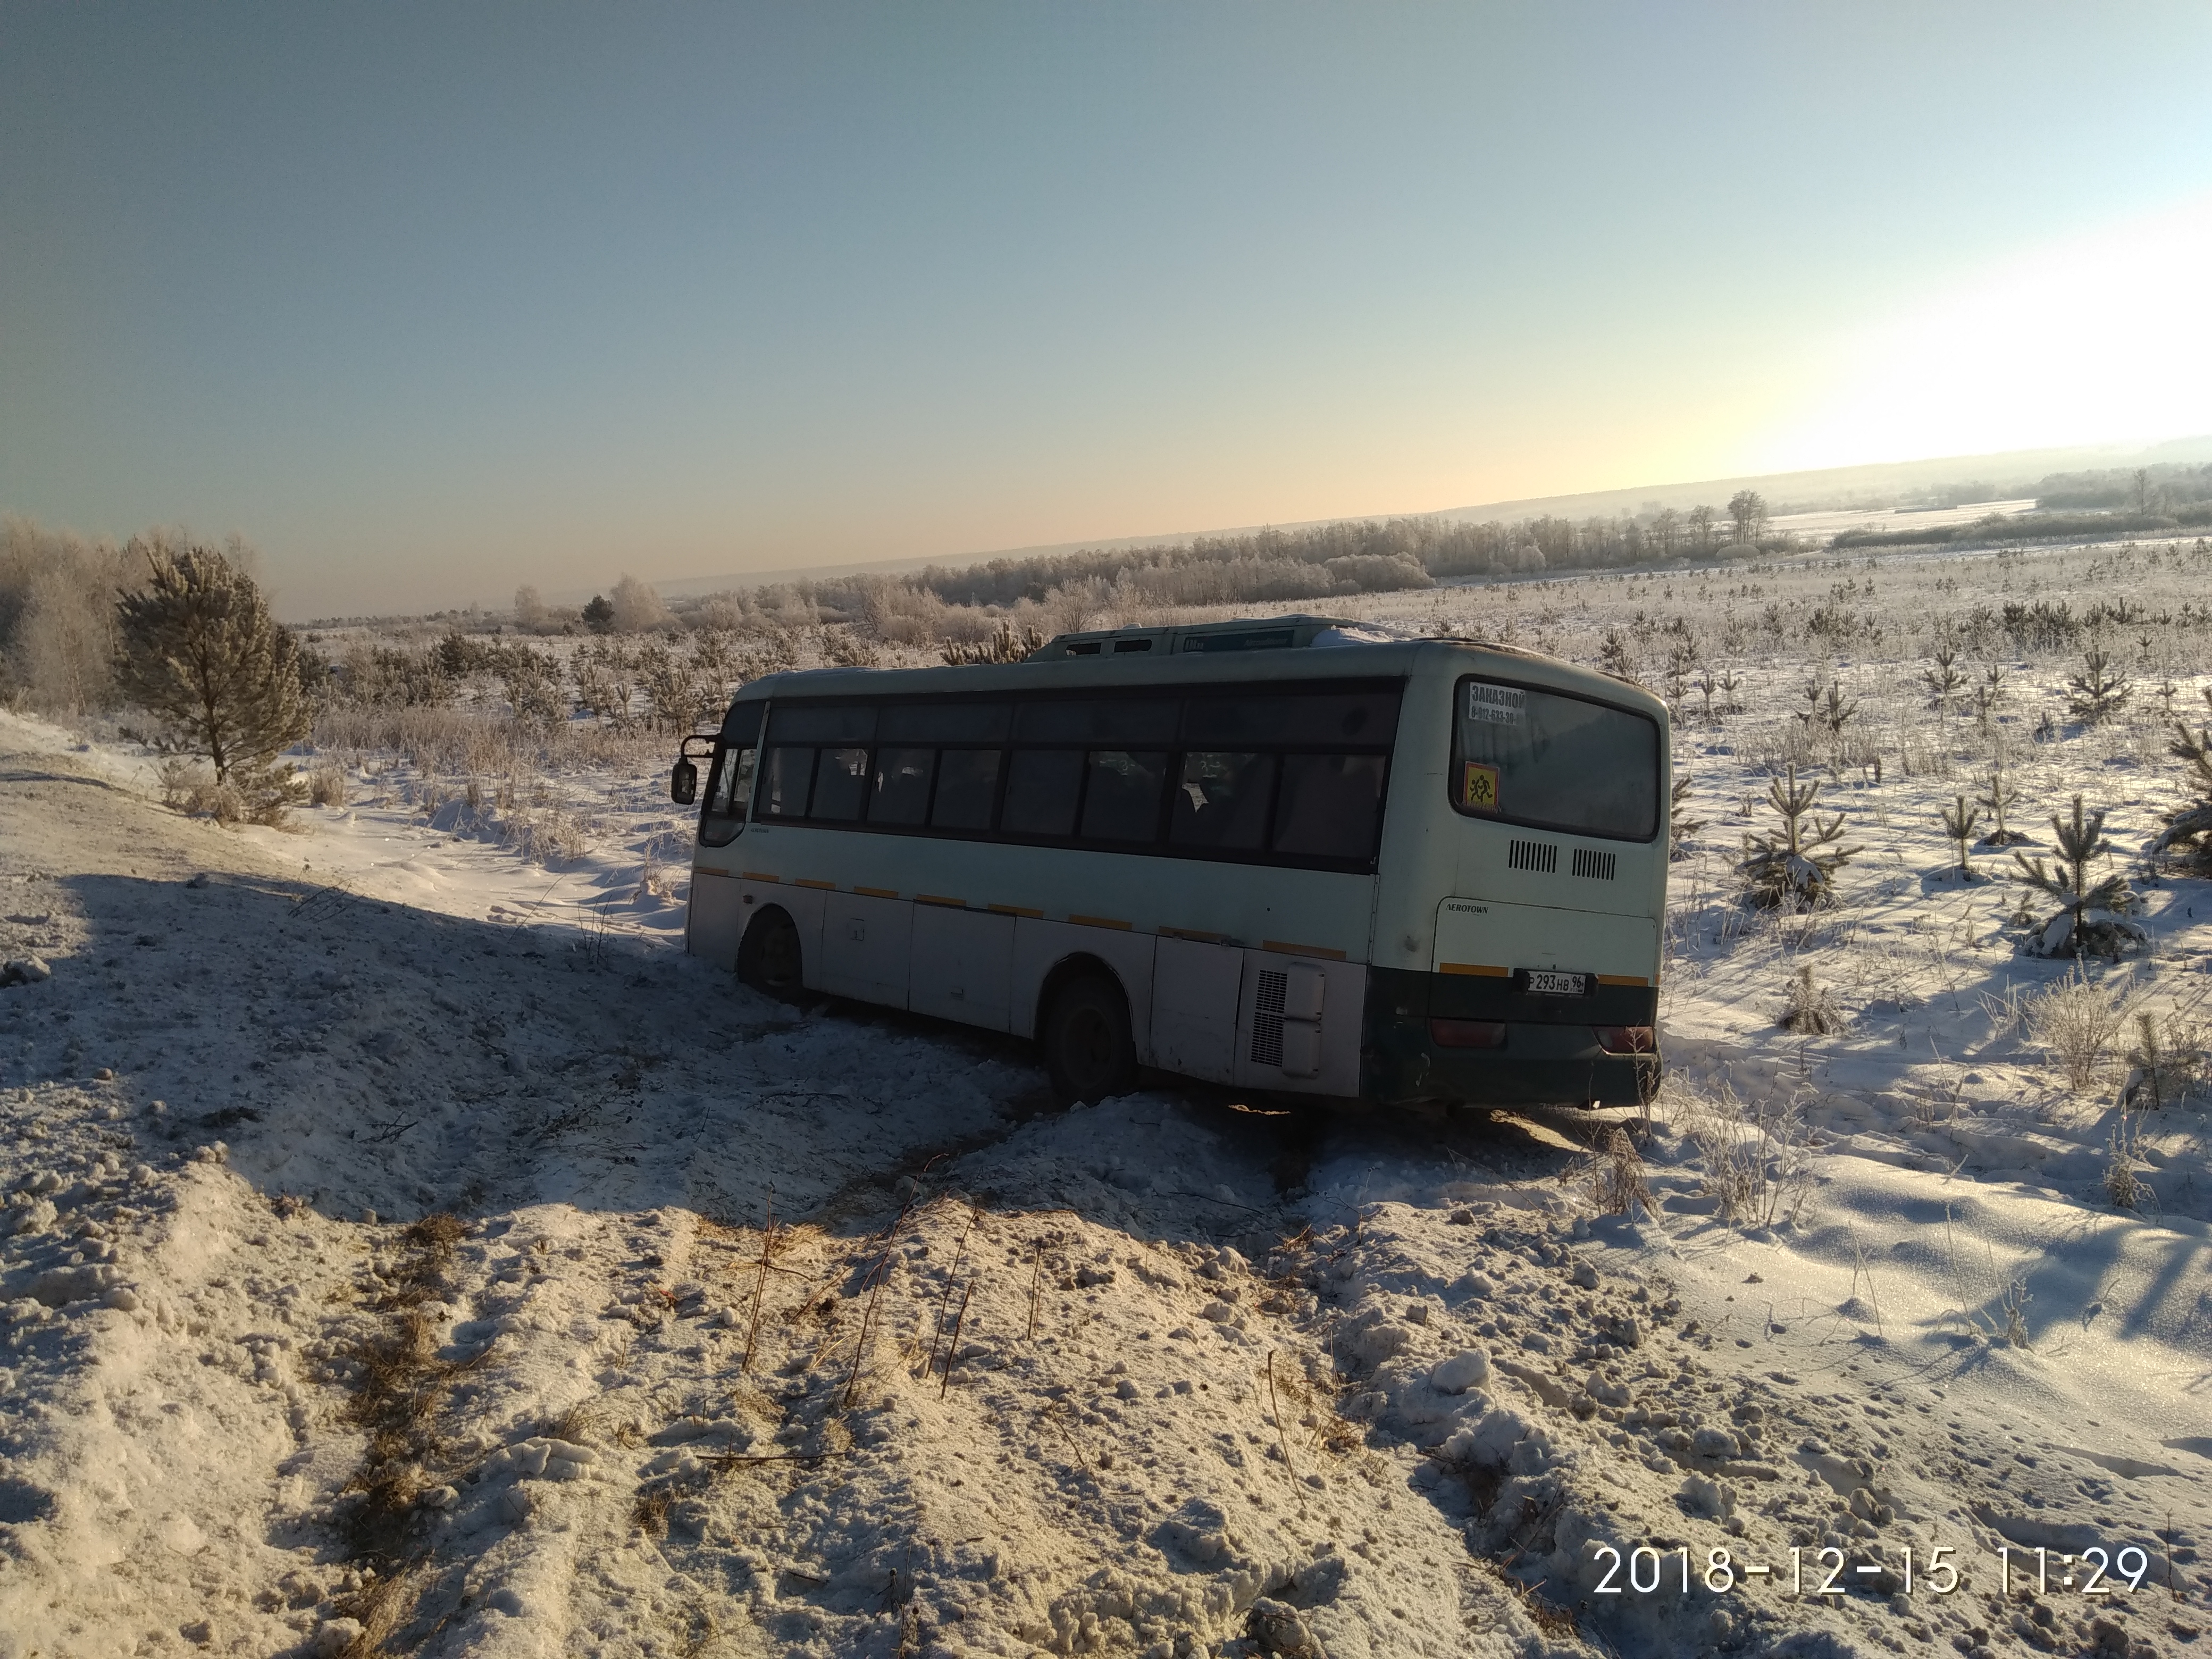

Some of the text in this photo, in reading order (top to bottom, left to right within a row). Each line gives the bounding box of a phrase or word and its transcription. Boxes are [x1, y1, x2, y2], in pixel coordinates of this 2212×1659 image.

[1472, 685, 1526, 708] ЗАКАЗНОЙ
[1445, 903, 1489, 914] AEROTOWN
[1572, 976, 1582, 988] 96
